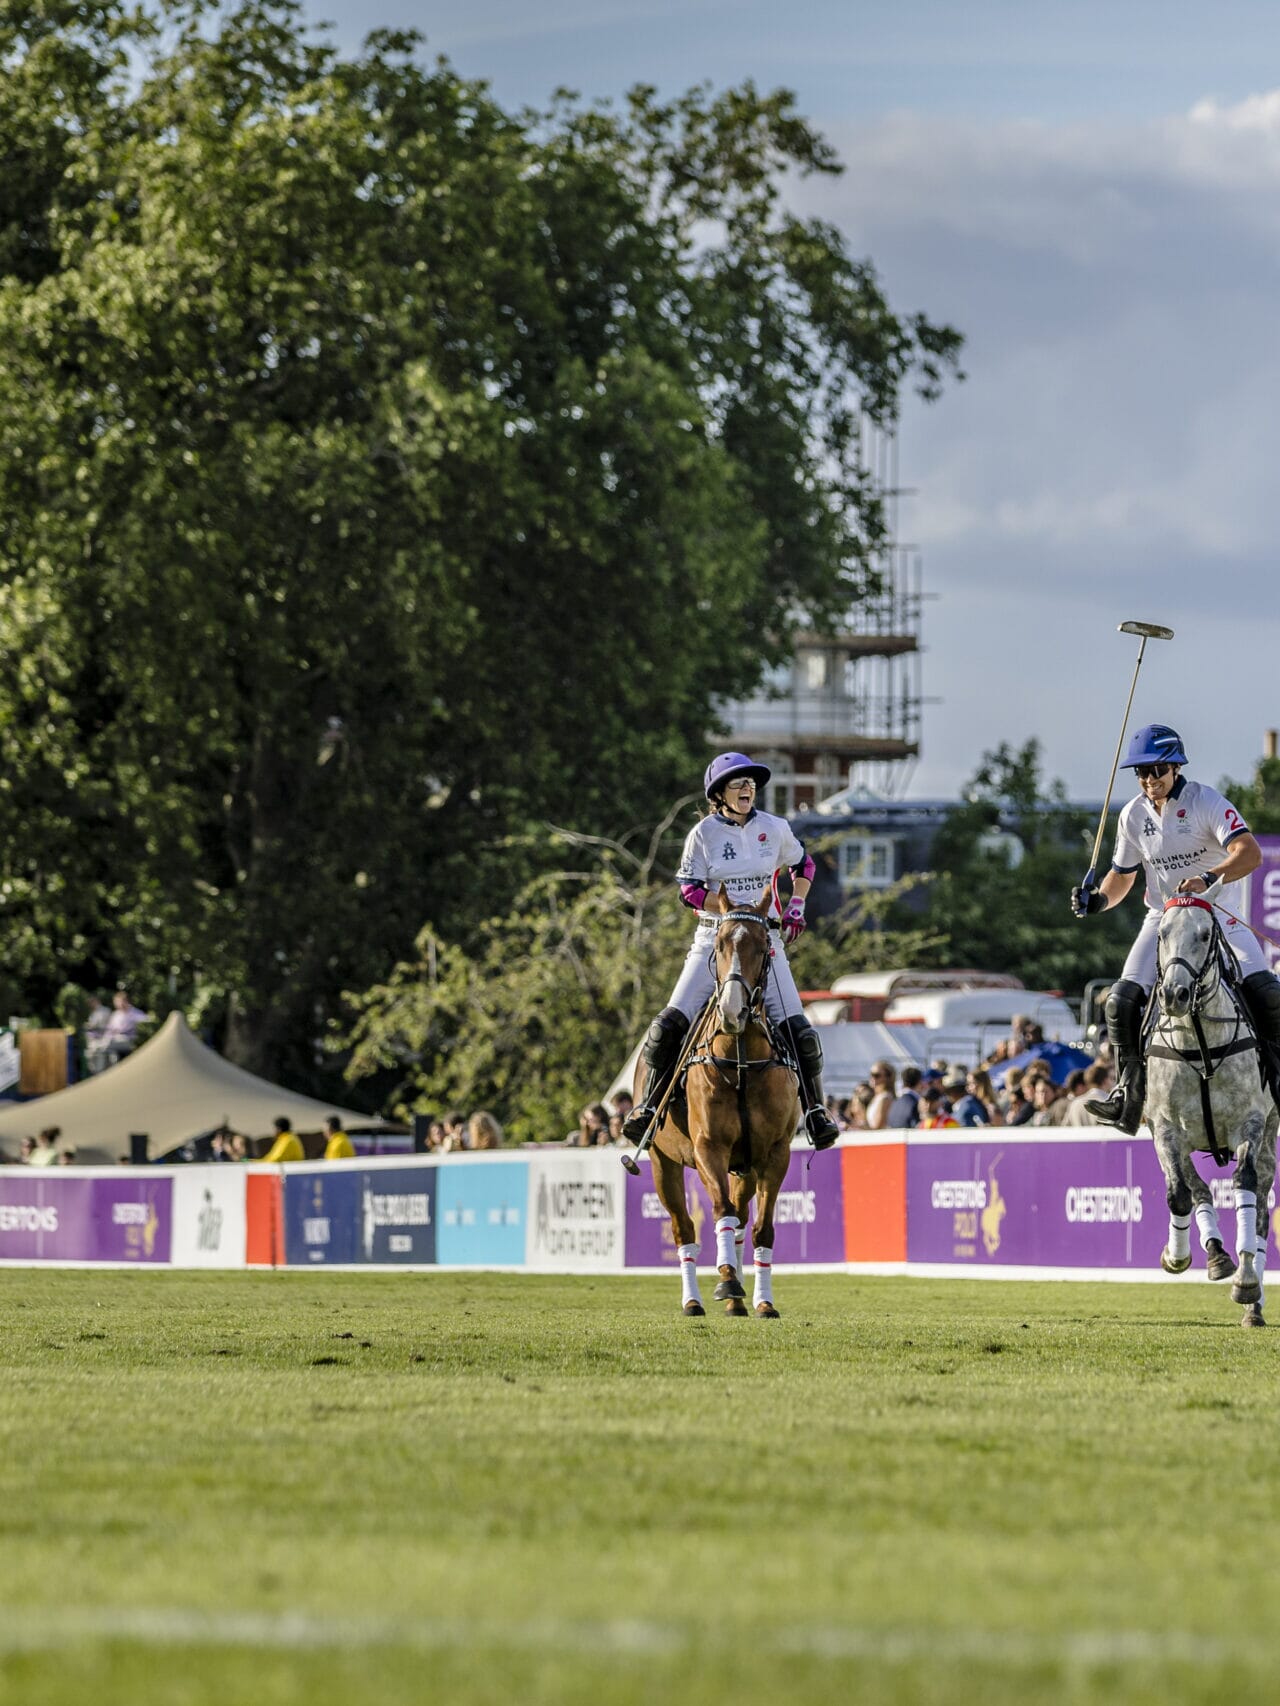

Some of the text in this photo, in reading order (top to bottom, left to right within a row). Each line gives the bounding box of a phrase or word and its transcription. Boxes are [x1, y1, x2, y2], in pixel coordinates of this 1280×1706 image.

[1224, 808, 1244, 831] 2
[1164, 860, 1191, 871] POLO
[738, 882, 763, 891] POLO
[1065, 1186, 1142, 1223] CHESTERTONS
